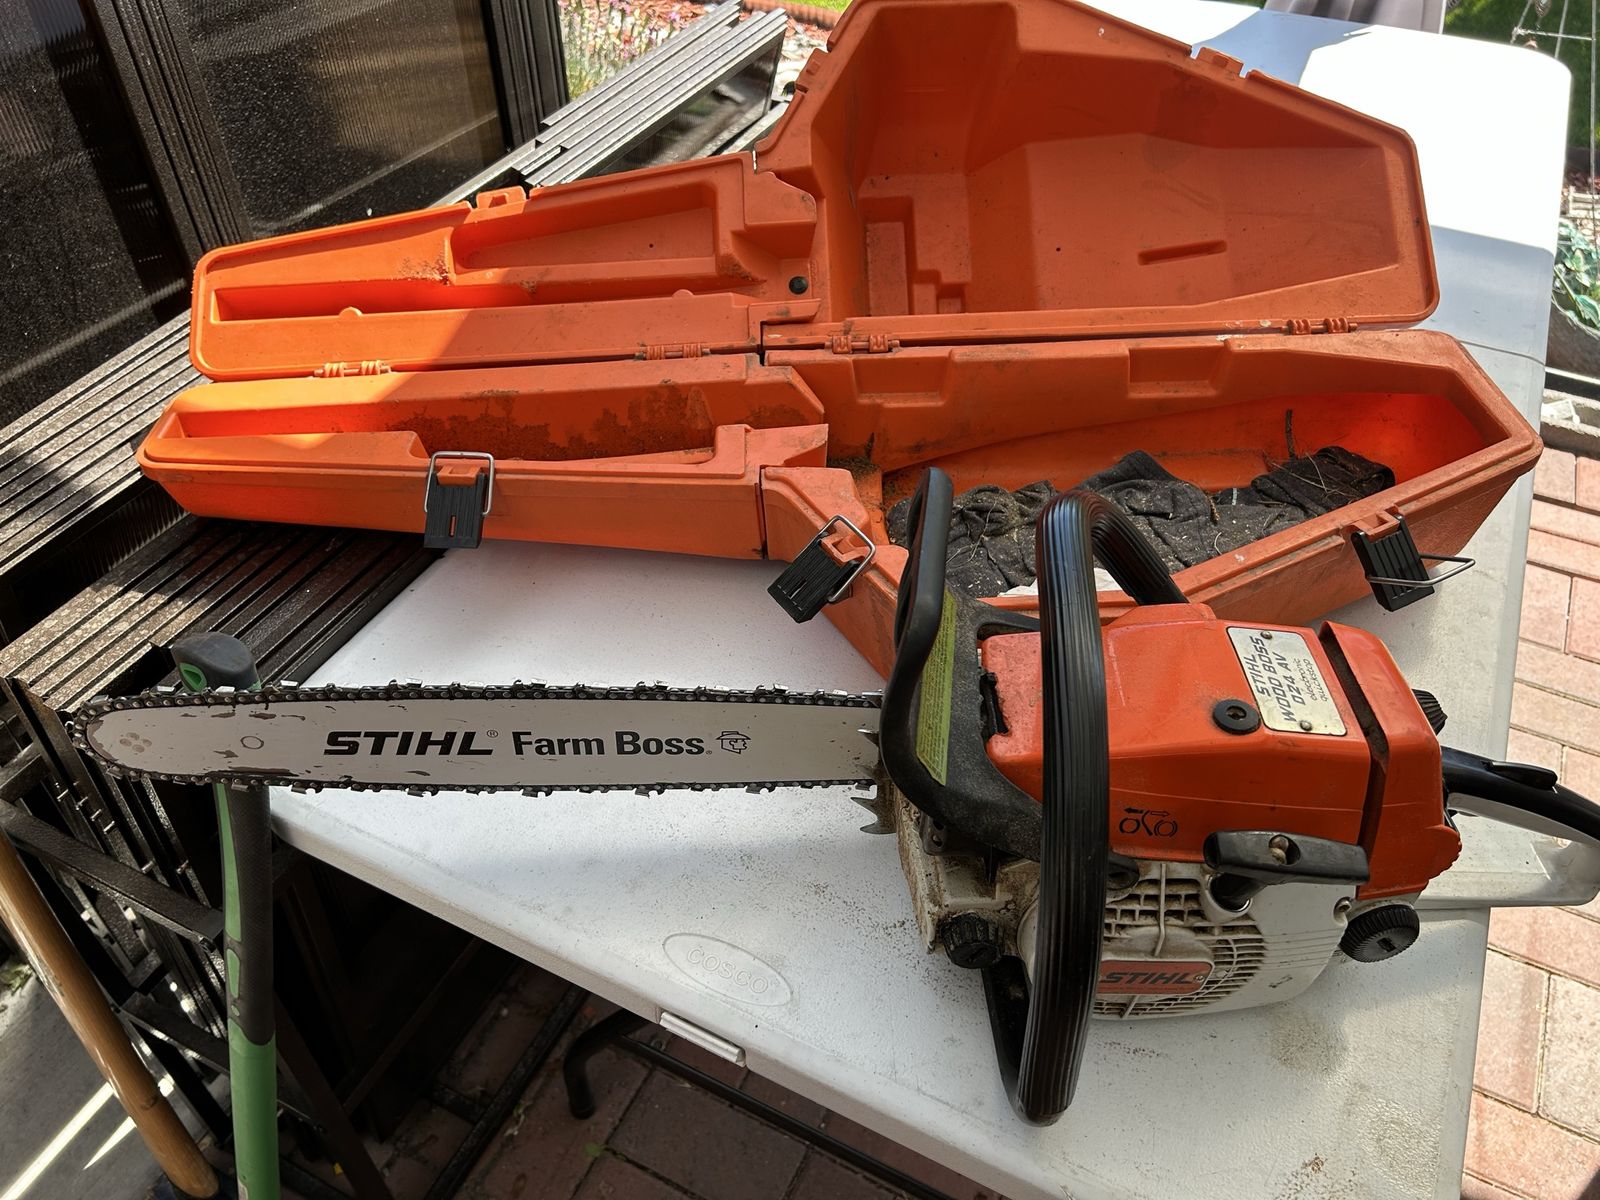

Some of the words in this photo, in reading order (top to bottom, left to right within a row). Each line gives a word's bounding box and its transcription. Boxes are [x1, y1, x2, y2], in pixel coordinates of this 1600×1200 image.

[1249, 635, 1277, 675] BOSS
[1272, 651, 1292, 672] AV
[1244, 655, 1271, 697] STIHL
[1283, 675, 1306, 706] 024
[1293, 657, 1318, 702] electronic
[1302, 658, 1328, 703] quickstop
[1269, 678, 1297, 722] WOOD
[511, 730, 605, 756] Farm
[615, 730, 706, 756] Boss
[687, 948, 768, 993] COSCO
[1099, 972, 1193, 985] STIHL
